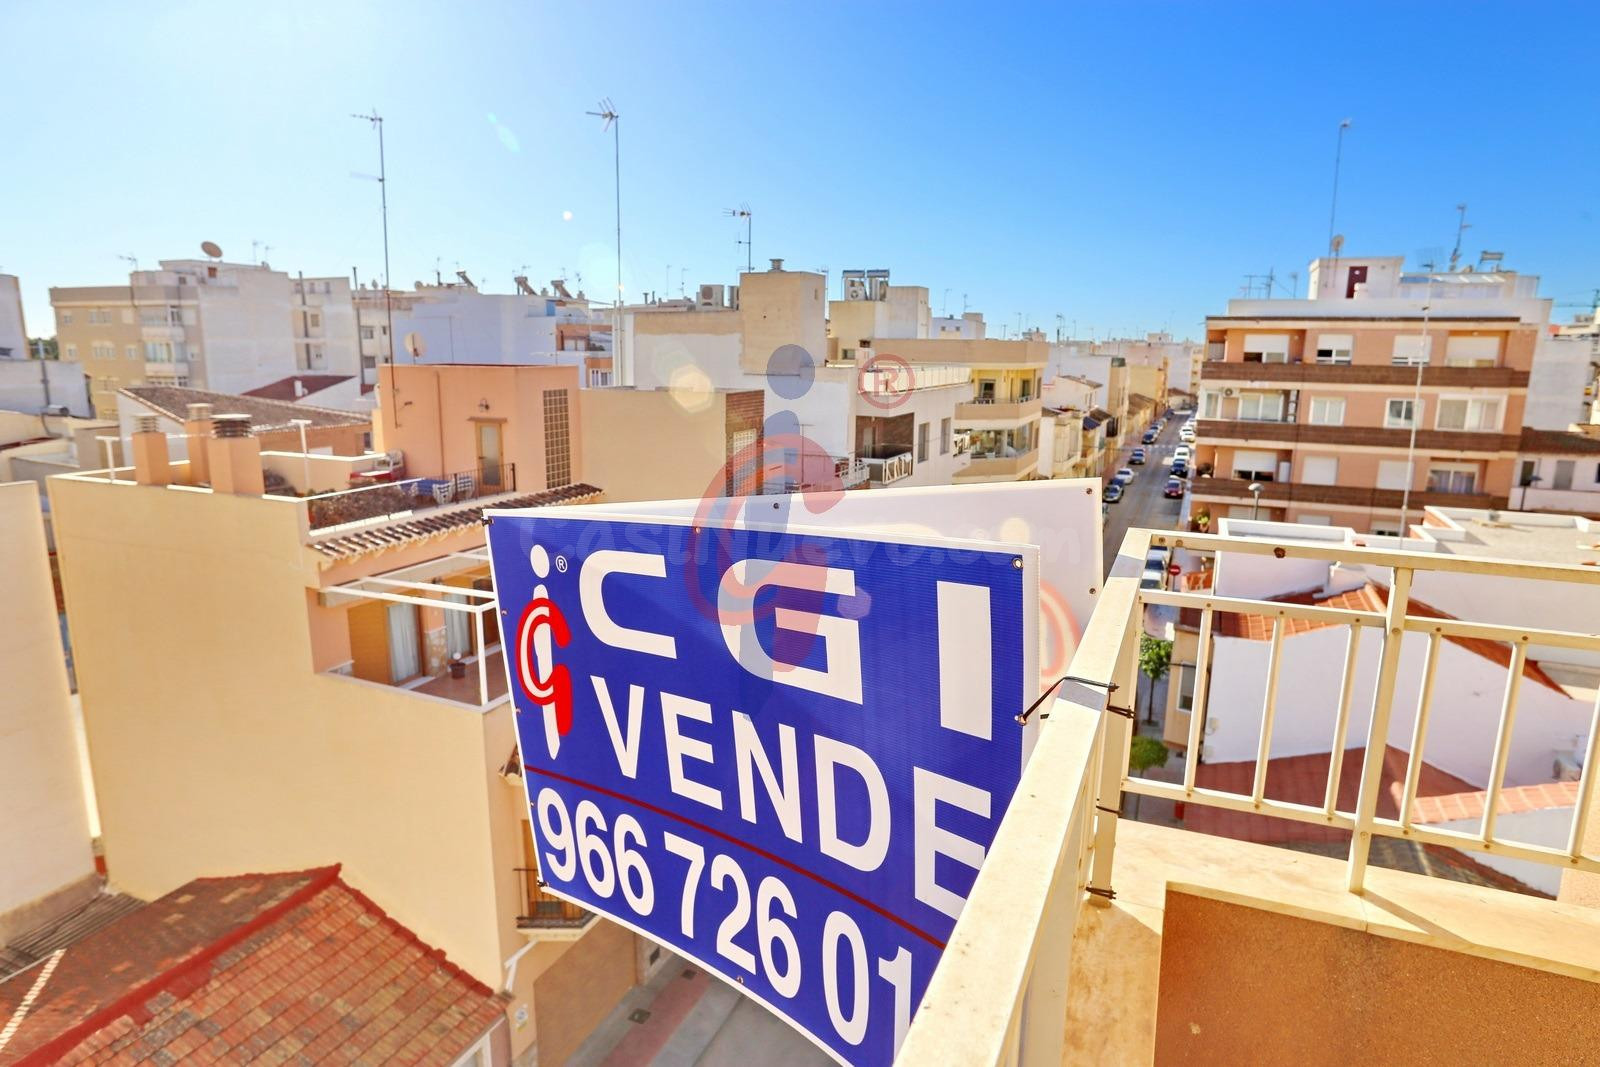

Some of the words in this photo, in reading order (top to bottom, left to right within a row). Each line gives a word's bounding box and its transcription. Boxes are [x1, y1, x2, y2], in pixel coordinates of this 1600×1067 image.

[579, 550, 993, 741] CGI
[590, 675, 992, 921] VENDE
[536, 788, 654, 917] 966
[663, 832, 802, 999] 726
[823, 910, 912, 1067] 01
